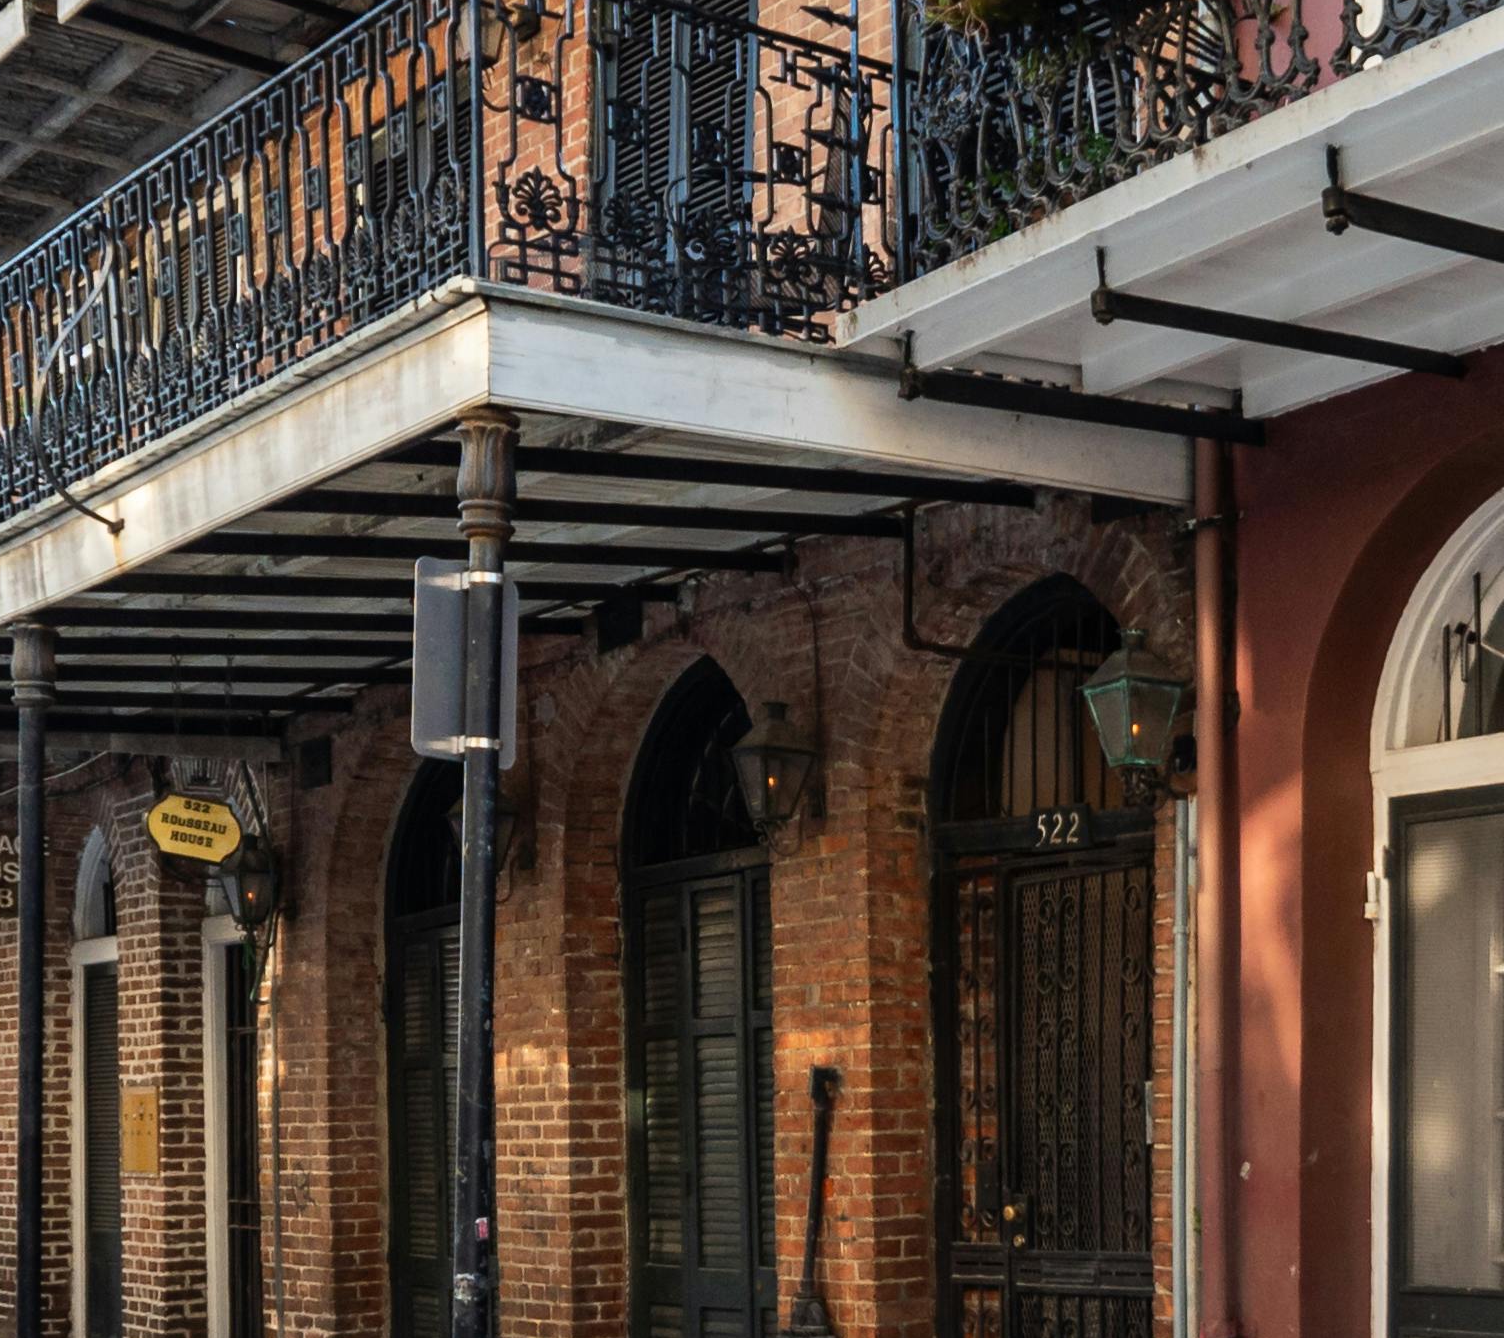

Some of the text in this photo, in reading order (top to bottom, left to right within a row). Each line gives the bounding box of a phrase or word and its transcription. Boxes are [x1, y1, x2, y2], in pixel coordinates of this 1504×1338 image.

[183, 799, 211, 814] 522
[169, 830, 214, 848] HOUSE
[1035, 812, 1079, 848] 522
